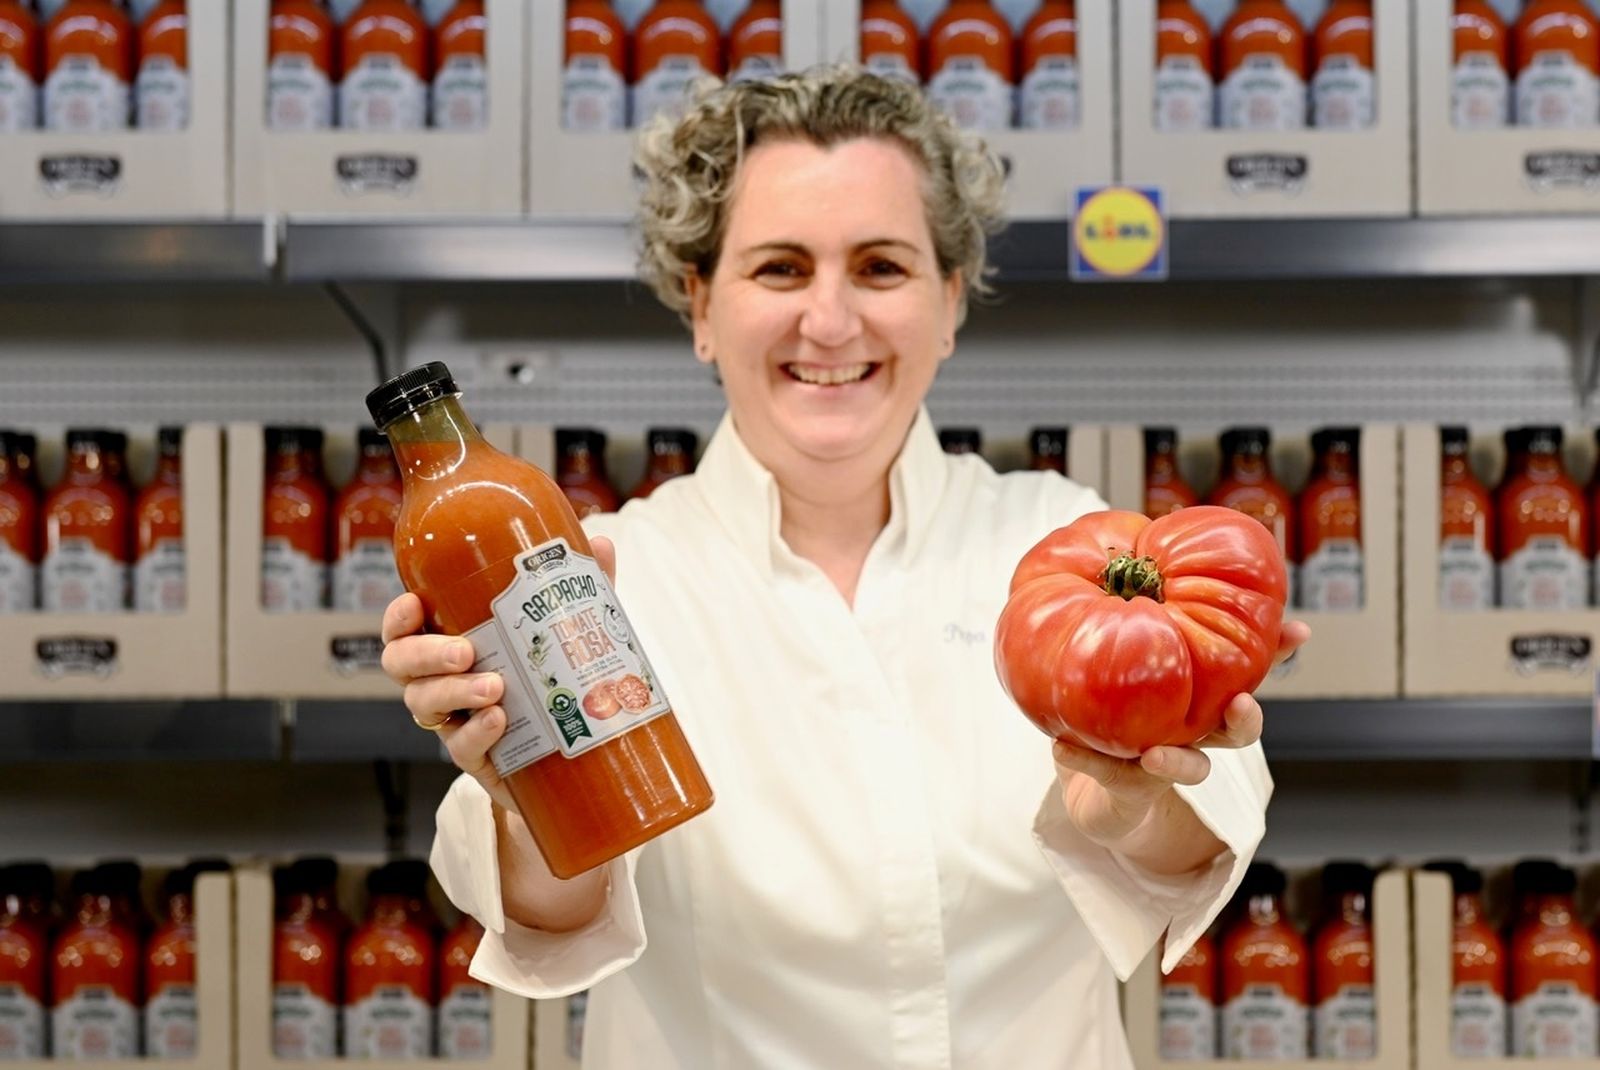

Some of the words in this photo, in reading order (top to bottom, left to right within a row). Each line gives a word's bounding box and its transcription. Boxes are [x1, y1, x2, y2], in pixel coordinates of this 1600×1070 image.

[527, 546, 563, 567] ORIGEN
[522, 574, 597, 623] GAZPACHO
[548, 607, 601, 644] TOMATE
[560, 626, 616, 670] ROSA
